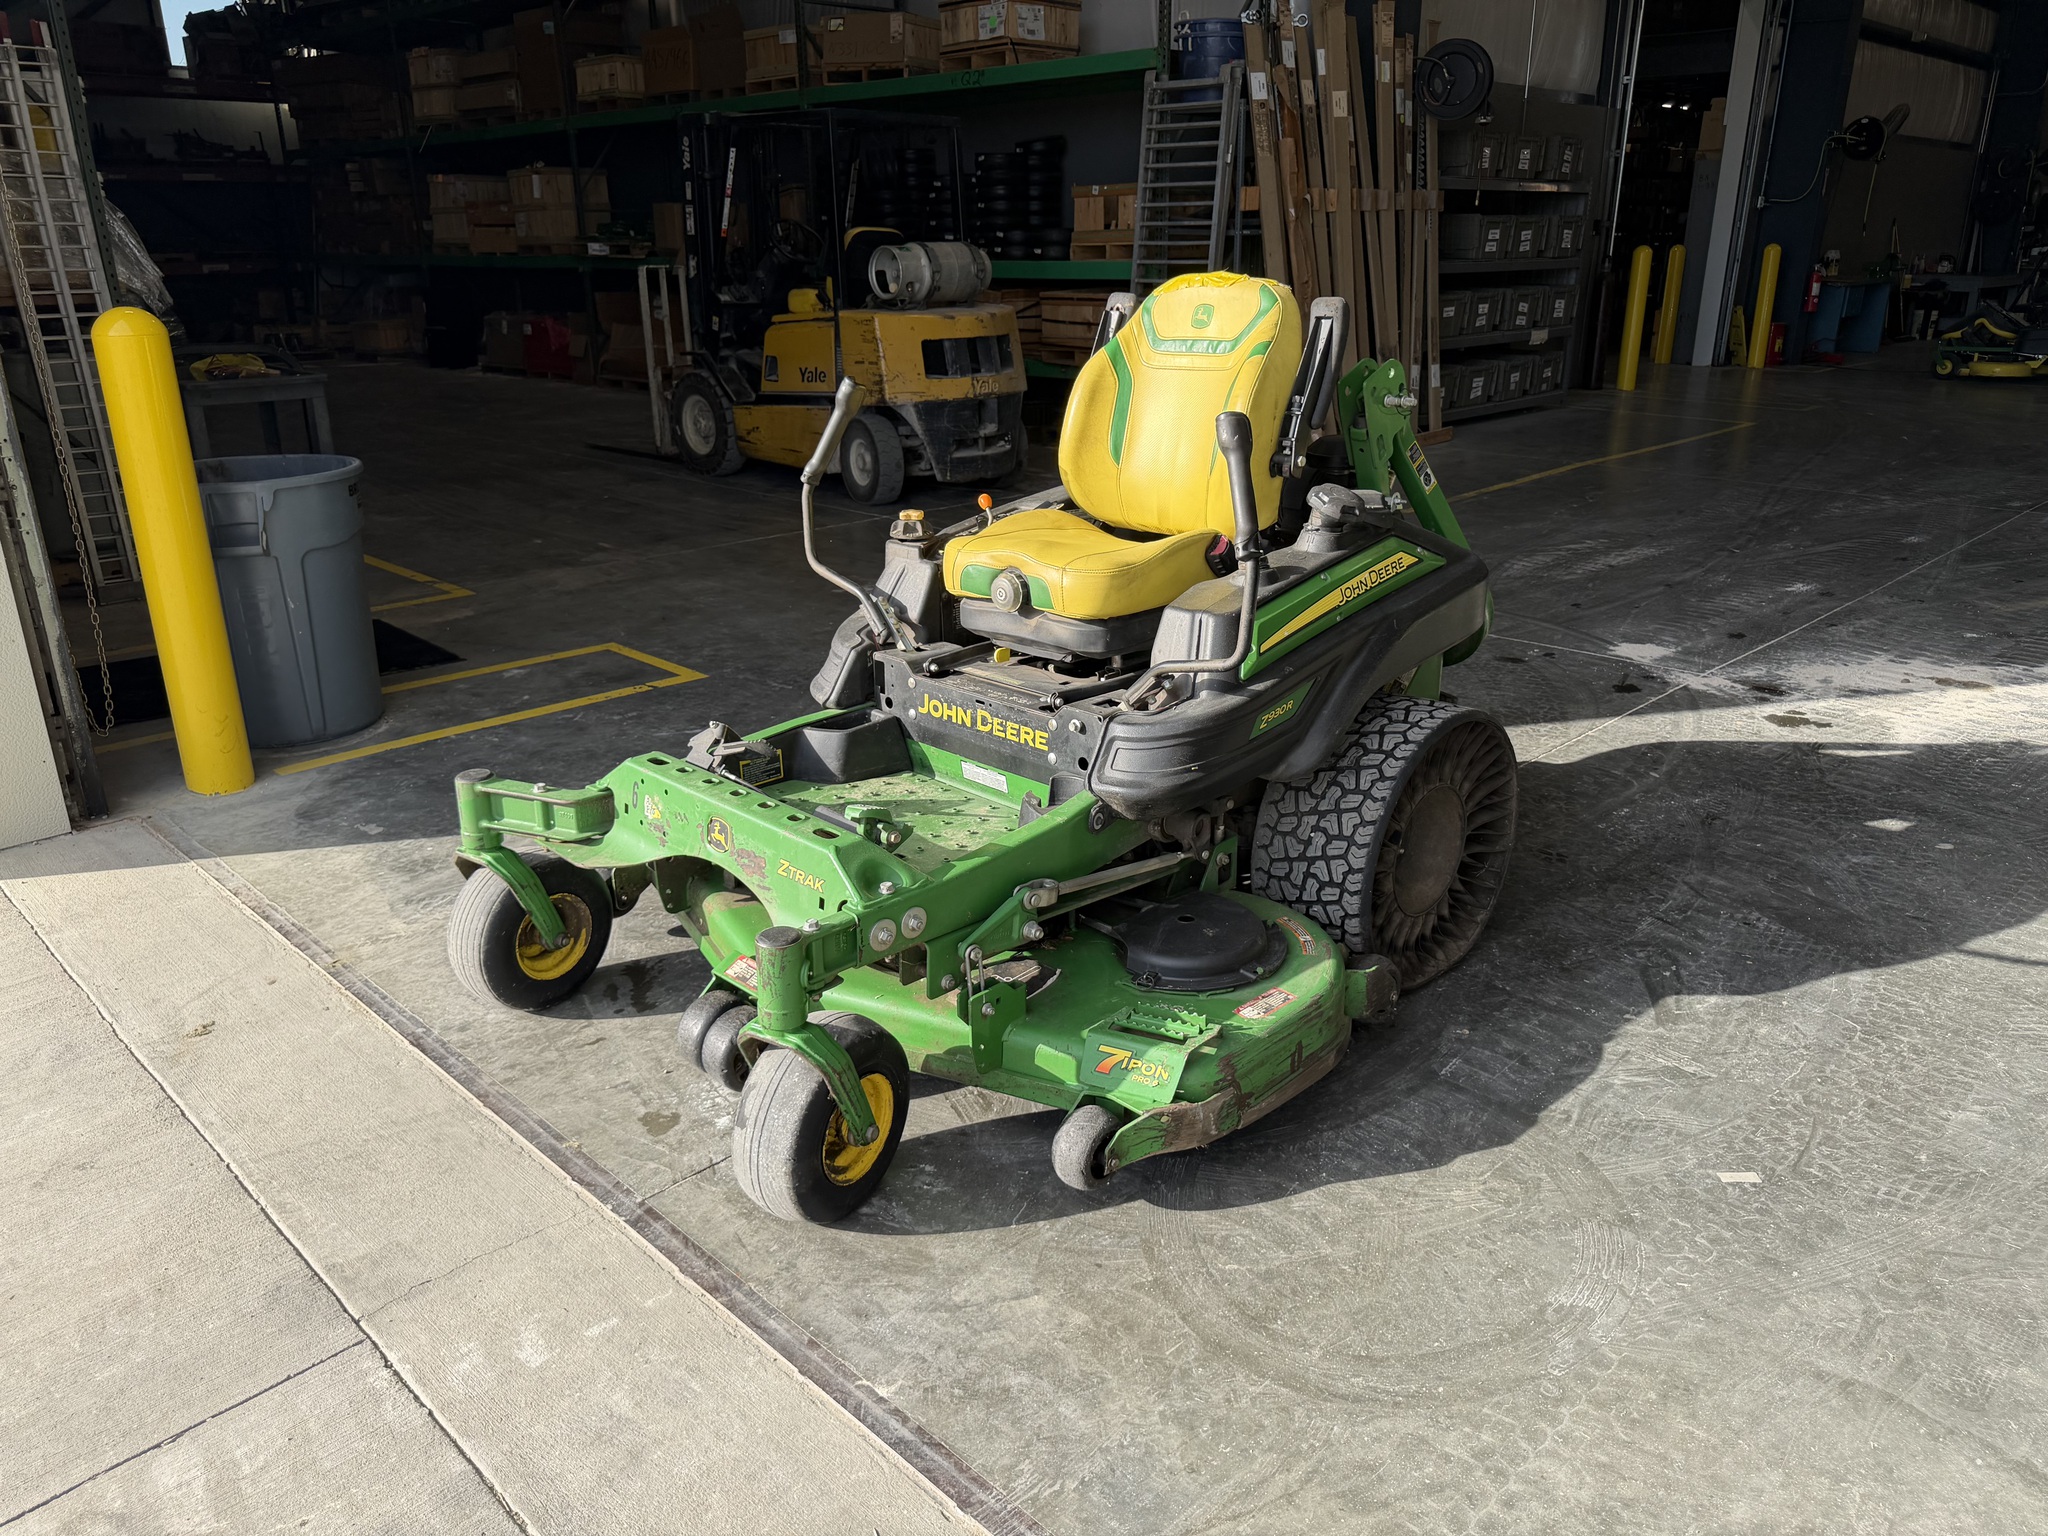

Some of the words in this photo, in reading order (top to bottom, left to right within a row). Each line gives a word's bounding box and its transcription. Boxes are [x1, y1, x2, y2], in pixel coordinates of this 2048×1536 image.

[682, 135, 691, 171] Yale
[799, 366, 827, 383] Yale
[972, 378, 999, 394] Yale
[1339, 577, 1368, 604] JOHN
[1368, 556, 1405, 585] DEERE
[918, 693, 972, 728] JOHN
[977, 708, 1049, 752] DEERE
[1259, 700, 1294, 730] Z930R
[777, 858, 825, 893] ZTRAK
[1131, 1074, 1151, 1085] PRO
